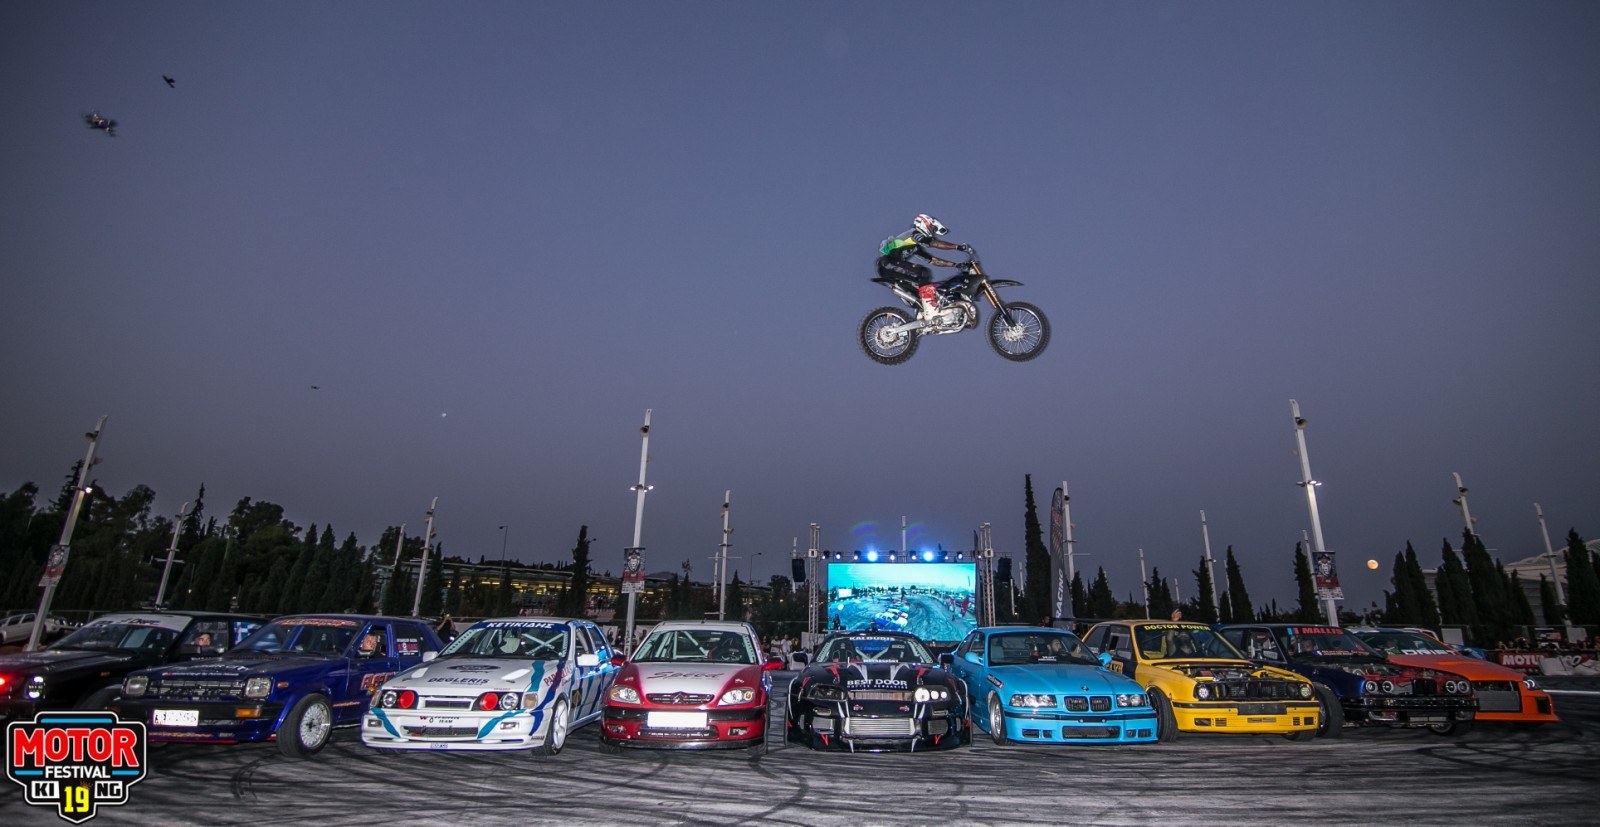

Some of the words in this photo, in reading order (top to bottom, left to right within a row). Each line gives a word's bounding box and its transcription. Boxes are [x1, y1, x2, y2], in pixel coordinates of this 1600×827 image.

[1055, 568, 1064, 618] RACING
[1301, 627, 1343, 635] MALLIS
[875, 679, 908, 687] DOOR
